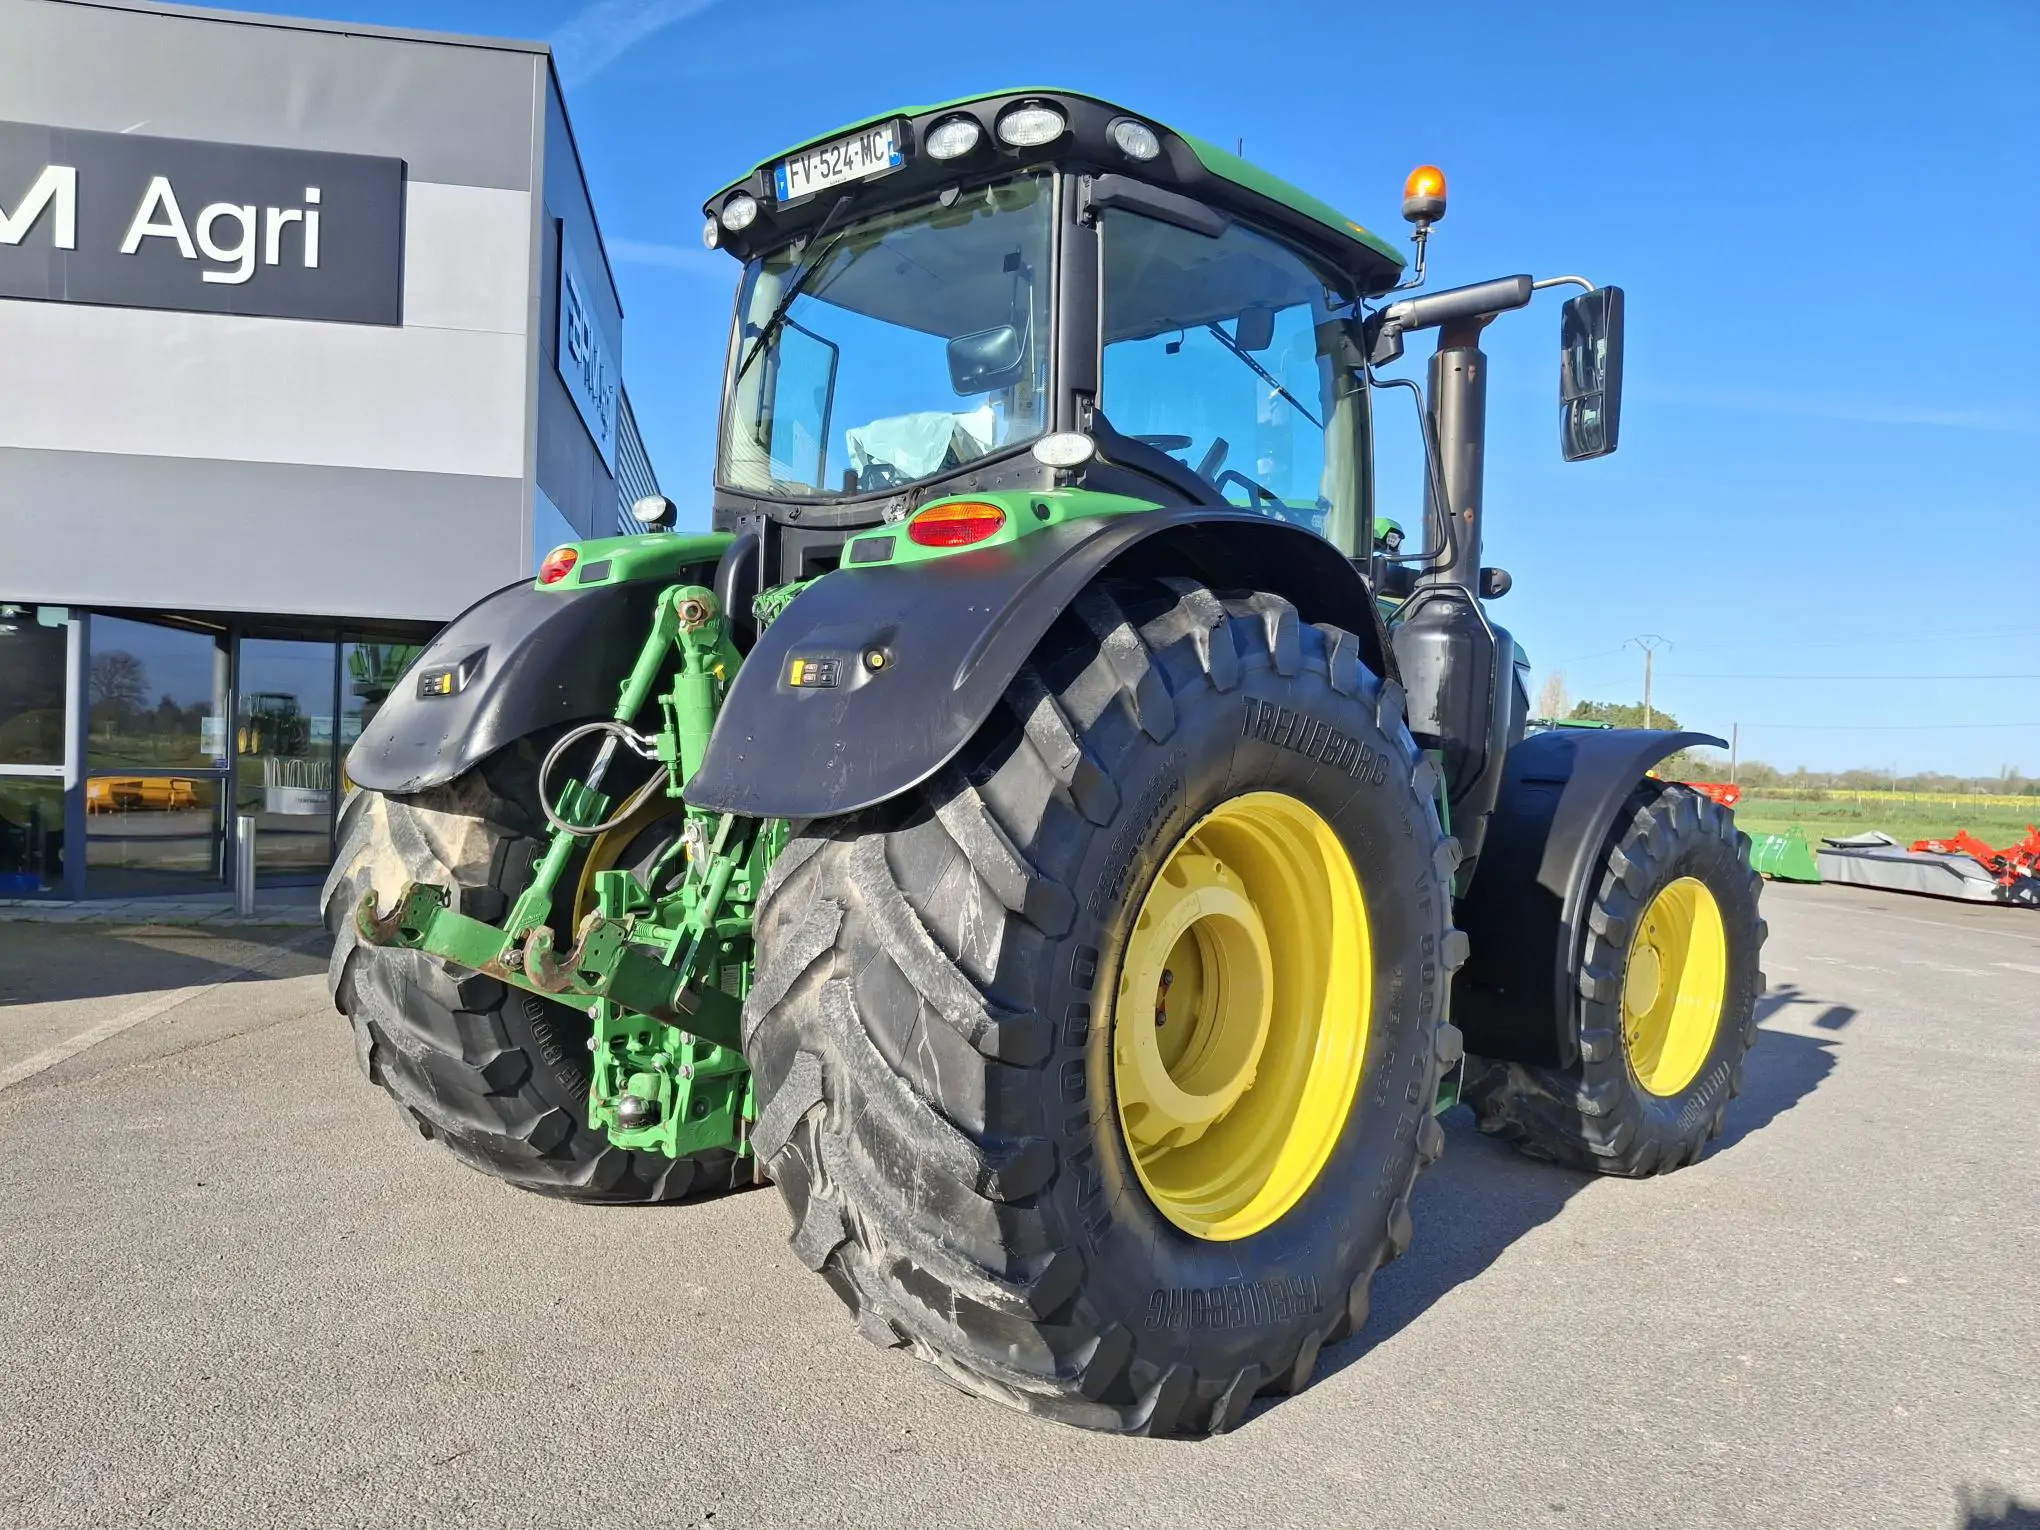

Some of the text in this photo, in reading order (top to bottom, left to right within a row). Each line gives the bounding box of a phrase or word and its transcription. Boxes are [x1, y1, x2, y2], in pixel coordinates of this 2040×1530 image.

[789, 131, 885, 188] FV-524-MC
[120, 176, 321, 284] Agri
[1241, 695, 1391, 786] TRELLEBORG
[1144, 1275, 1324, 1332] TRELLEBORG
